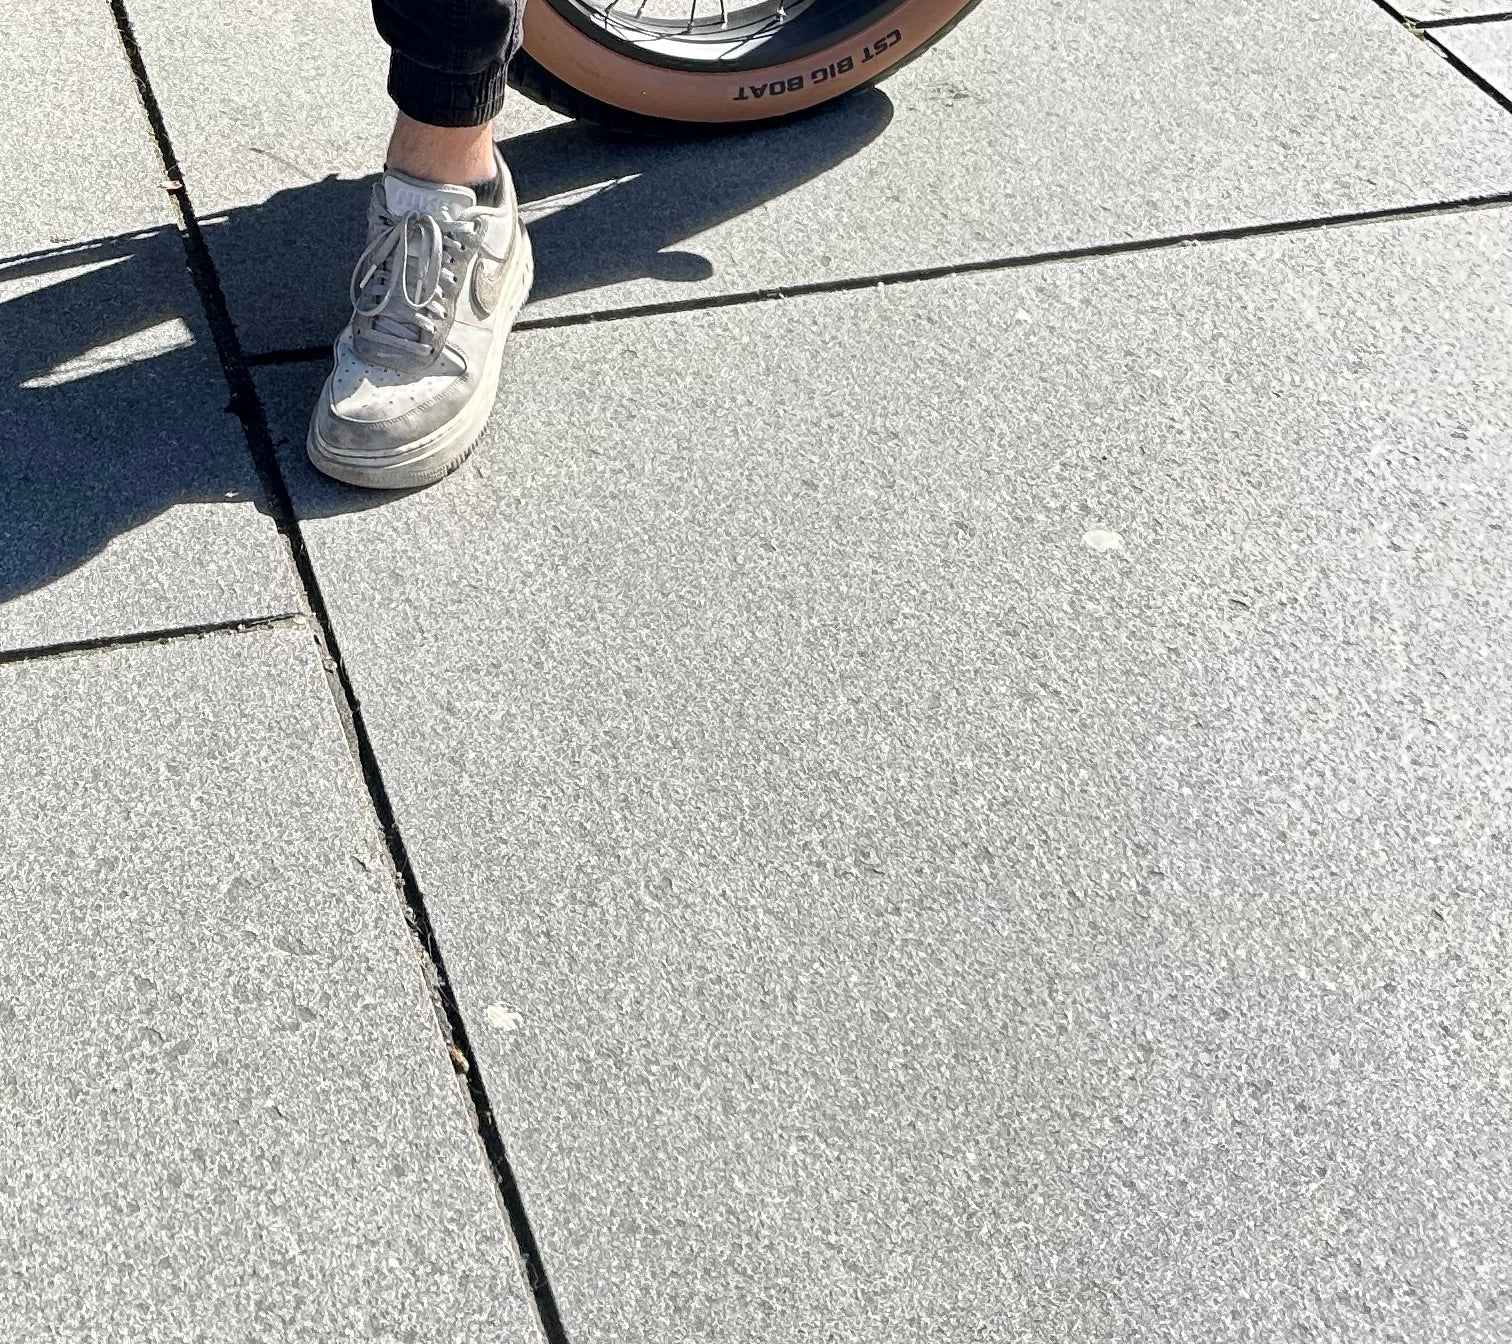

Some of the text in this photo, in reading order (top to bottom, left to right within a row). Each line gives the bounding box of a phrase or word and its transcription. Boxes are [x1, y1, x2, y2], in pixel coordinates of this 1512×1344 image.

[733, 28, 902, 101] CST BIG BOAT
